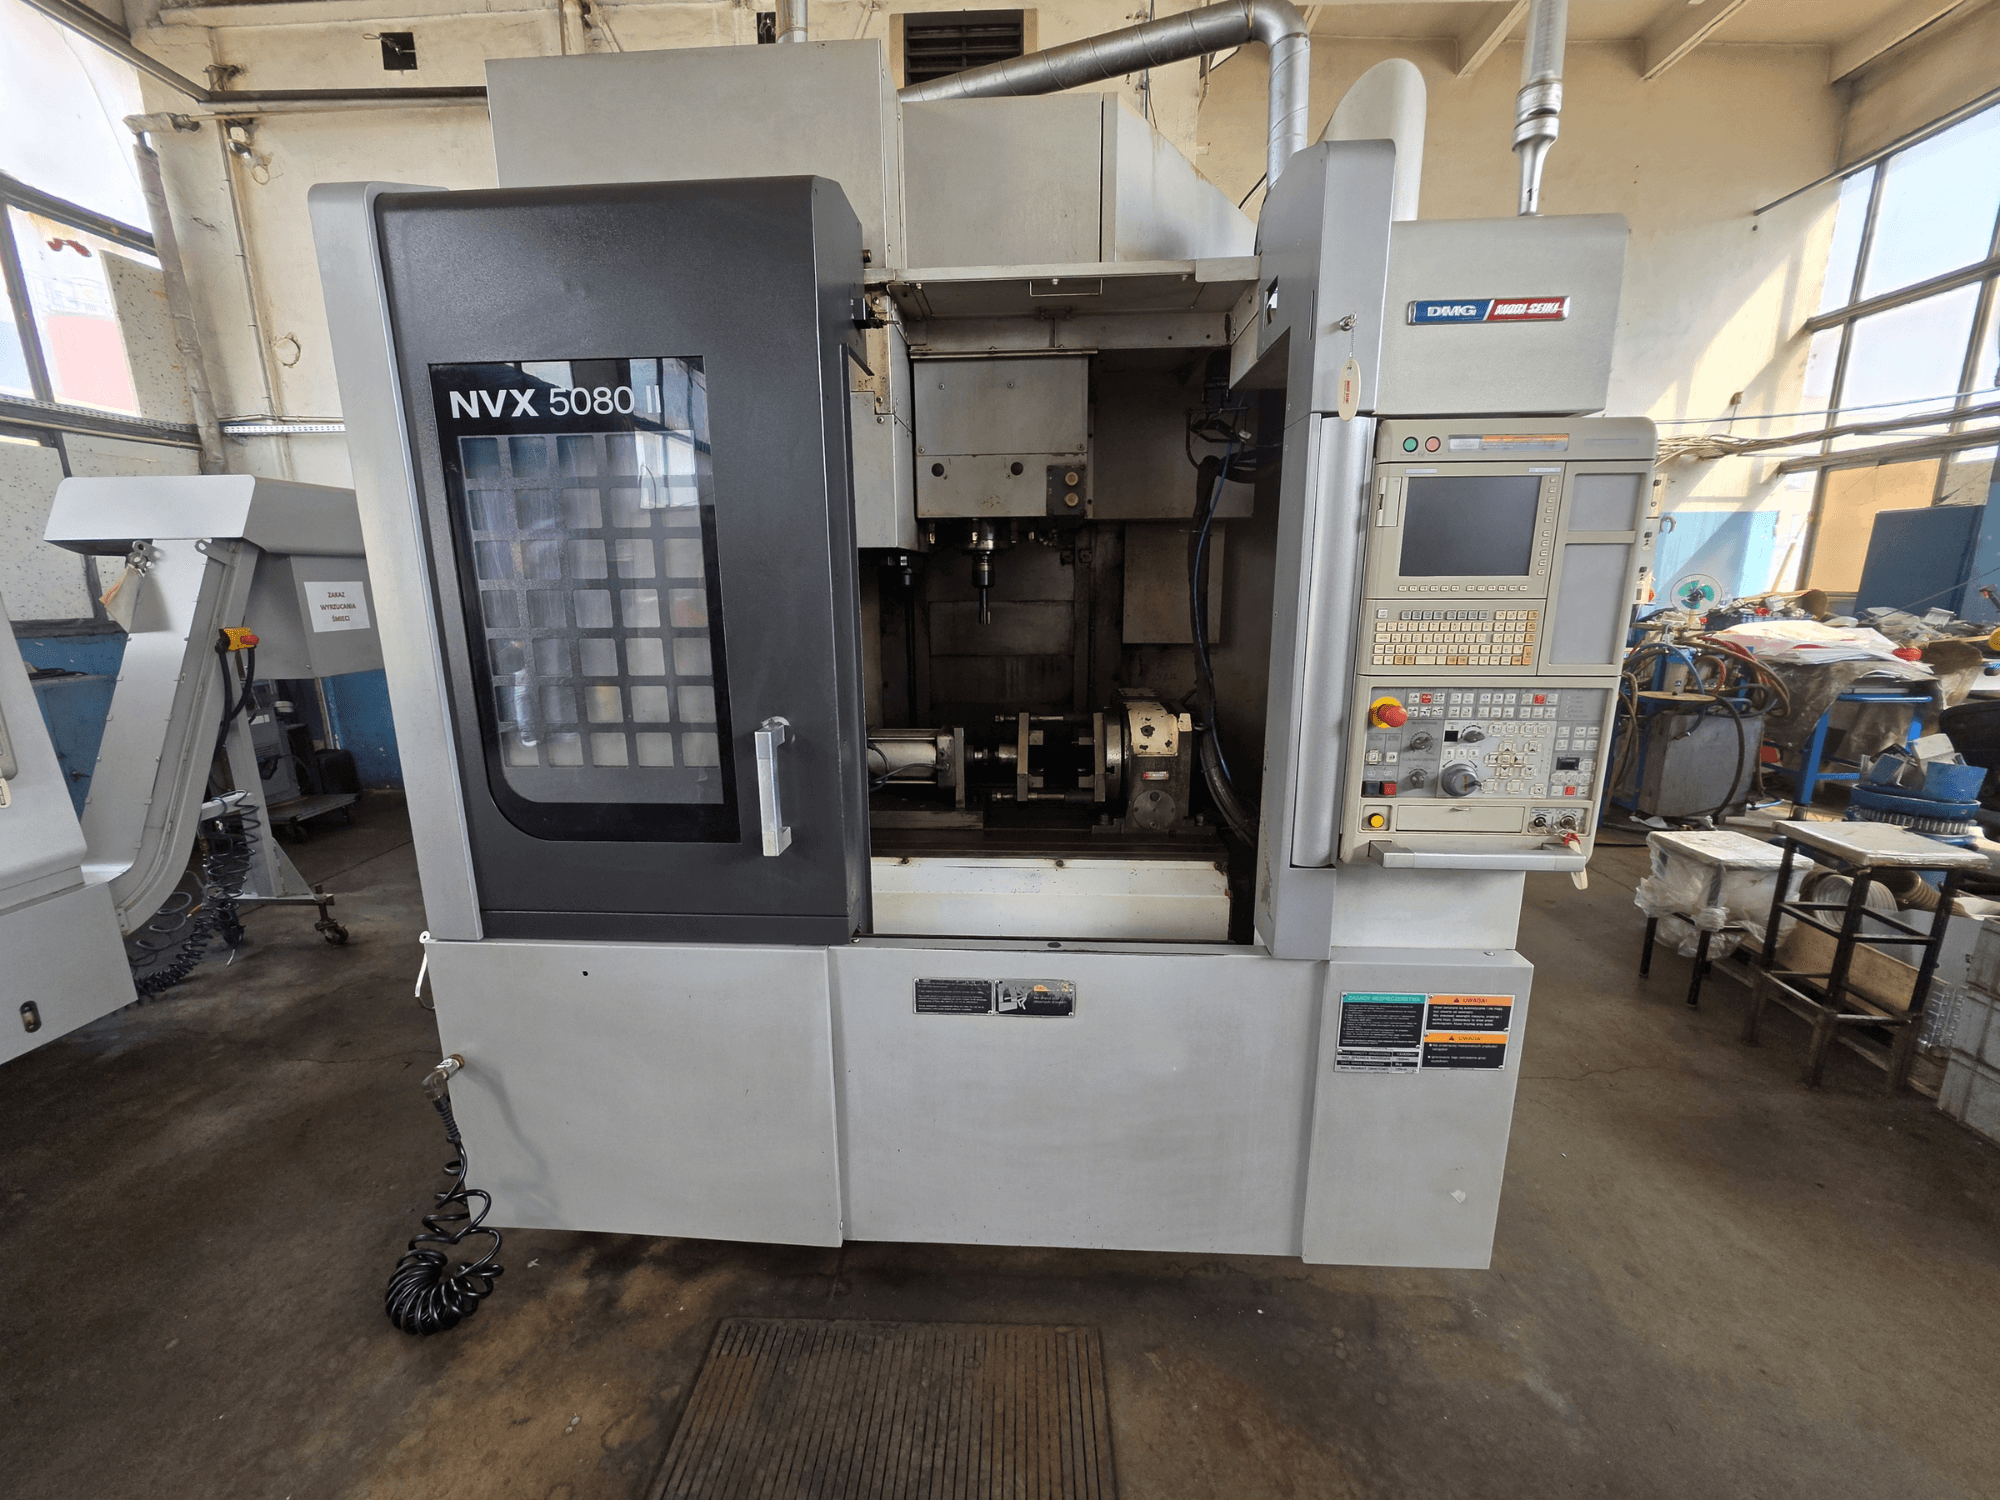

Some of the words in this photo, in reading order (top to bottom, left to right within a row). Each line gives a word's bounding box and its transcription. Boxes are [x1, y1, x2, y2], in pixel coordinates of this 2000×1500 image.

[1427, 305, 1476, 317] DMG
[1494, 303, 1527, 315] MORI
[1528, 302, 1560, 314] SEIKI
[449, 388, 539, 418] NVX
[549, 386, 635, 416] 5080
[645, 385, 661, 414] II
